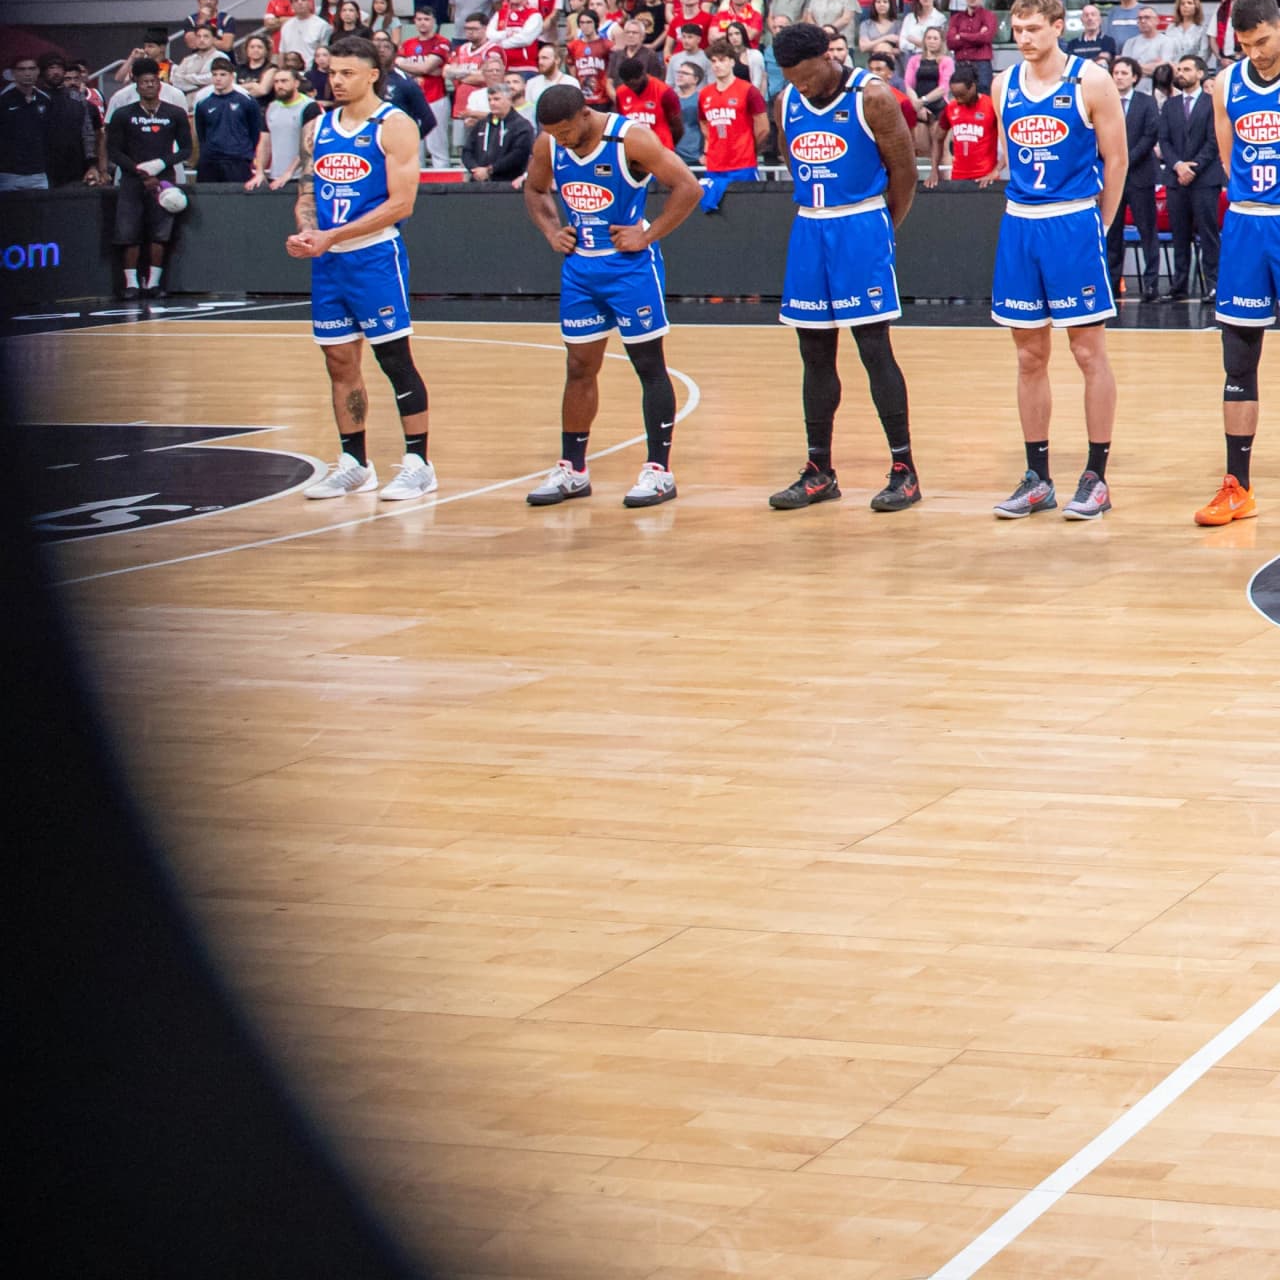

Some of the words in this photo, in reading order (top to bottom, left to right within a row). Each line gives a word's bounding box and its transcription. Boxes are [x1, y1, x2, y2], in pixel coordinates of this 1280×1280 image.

[1018, 118, 1057, 131] UCAM
[799, 134, 836, 147] UCAM
[1013, 131, 1064, 144] MURCIA
[795, 147, 842, 160] MURCIA
[324, 157, 360, 167] UCAM
[320, 167, 366, 180] MURCIA
[1033, 162, 1046, 189] 2
[1252, 165, 1277, 192] 99
[567, 185, 602, 197] UCAM
[813, 183, 825, 208] 0
[332, 199, 351, 223] 12
[582, 227, 595, 247] 5
